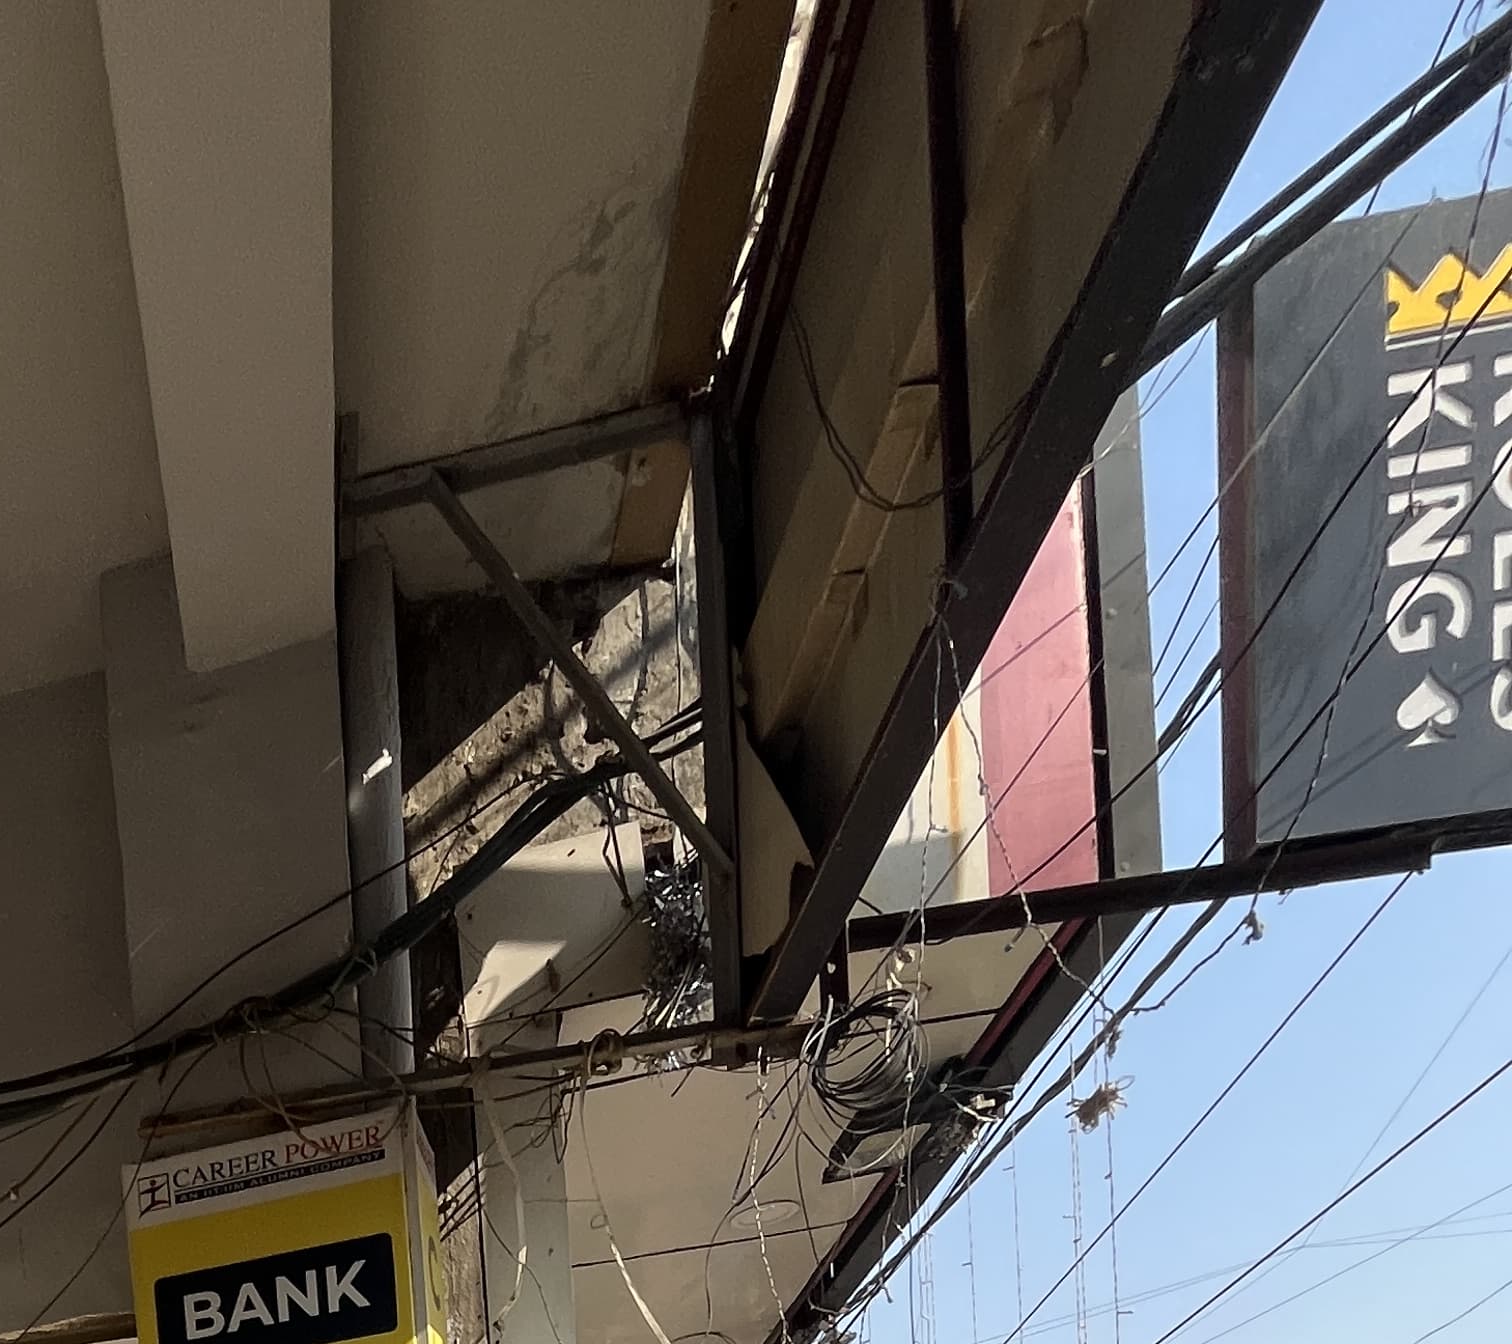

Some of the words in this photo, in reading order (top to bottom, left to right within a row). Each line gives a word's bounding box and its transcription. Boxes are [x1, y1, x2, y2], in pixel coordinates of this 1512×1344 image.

[1387, 360, 1473, 655] KING
[173, 1150, 277, 1188] CAREER
[285, 1126, 381, 1164] POWER
[180, 1190, 199, 1202] AN
[250, 1168, 305, 1187] ALUMNI
[309, 1151, 381, 1173] COMPANY
[183, 1260, 370, 1341] BANK
